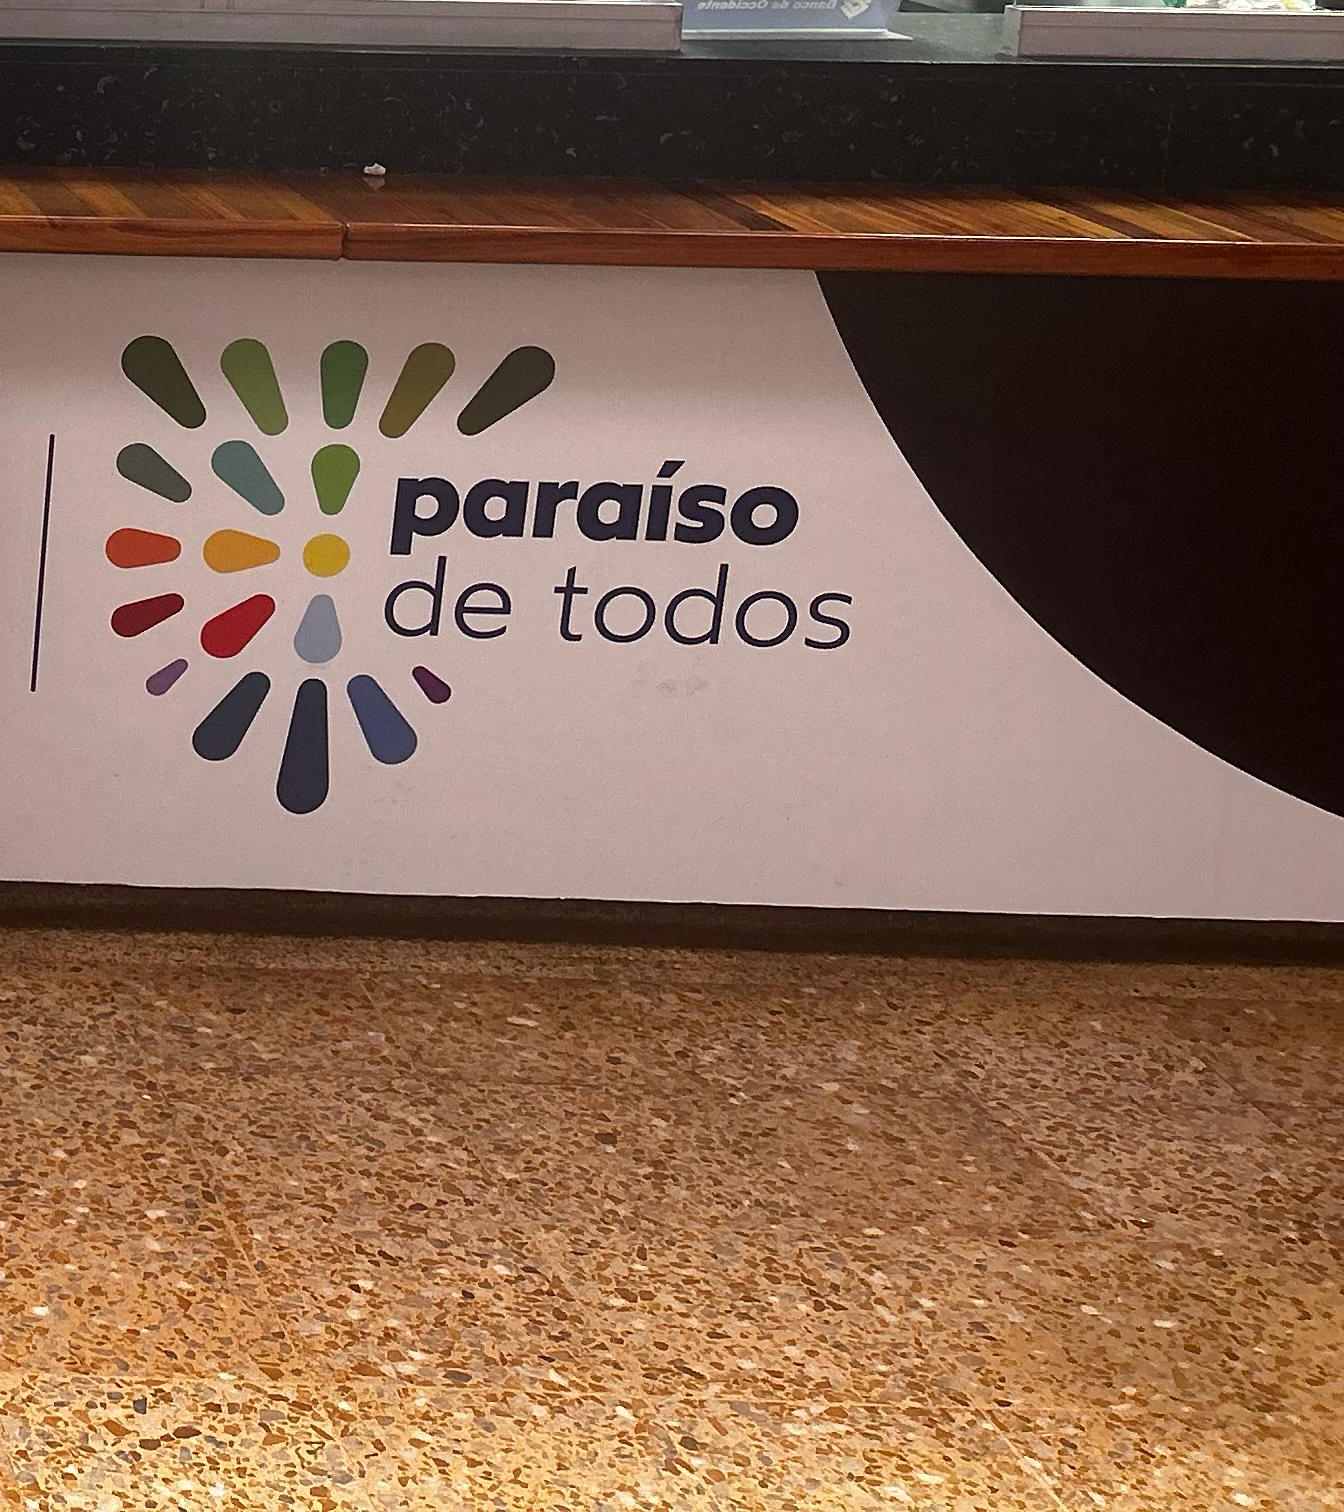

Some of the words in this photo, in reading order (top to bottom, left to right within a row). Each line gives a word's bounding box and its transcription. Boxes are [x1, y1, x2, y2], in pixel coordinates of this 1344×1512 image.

[390, 460, 799, 555] paraíso
[384, 556, 512, 639] de
[554, 563, 852, 650] todos
